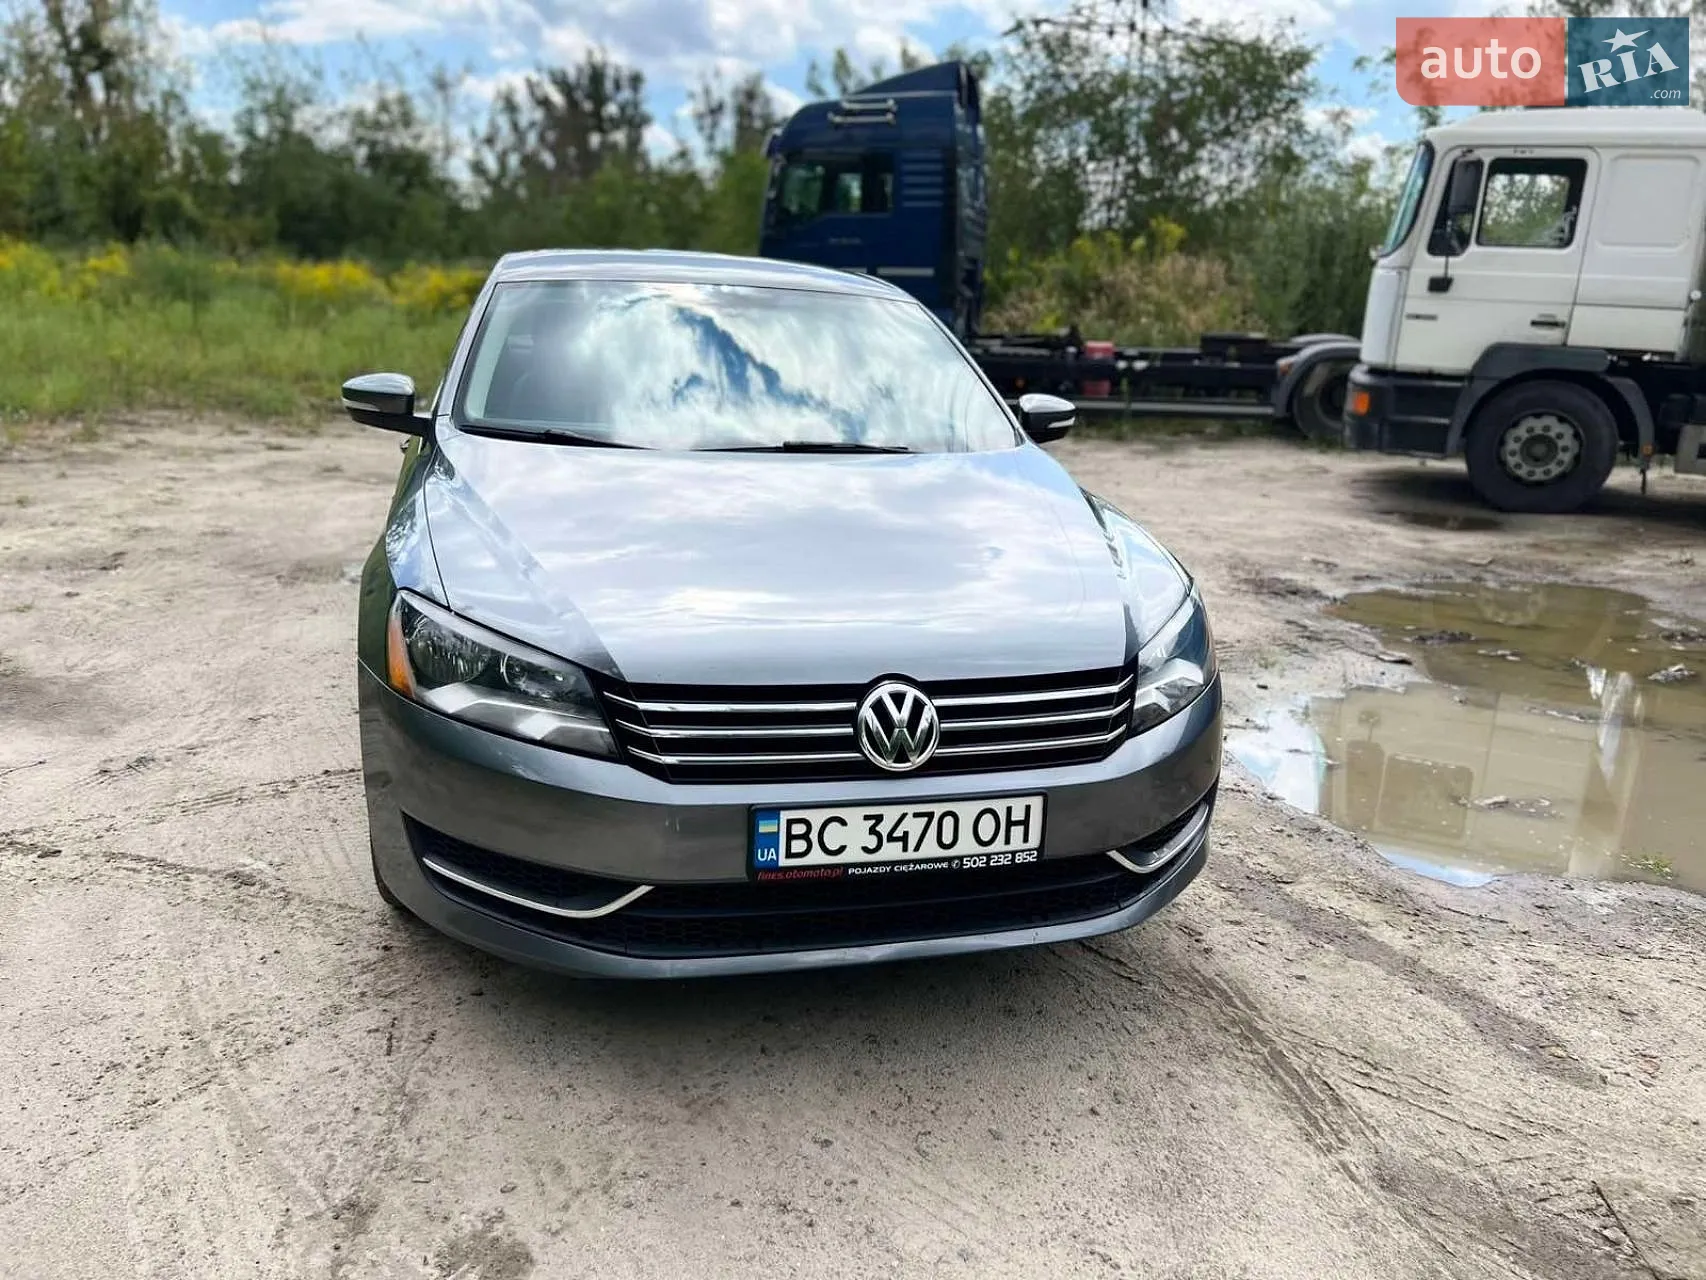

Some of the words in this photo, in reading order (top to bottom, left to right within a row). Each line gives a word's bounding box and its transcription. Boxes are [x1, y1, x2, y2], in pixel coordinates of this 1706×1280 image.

[861, 685, 936, 769] VW
[784, 815, 848, 859] BC
[861, 810, 960, 855] 3470
[972, 804, 1032, 847] OH
[757, 848, 777, 862] UA
[848, 865, 891, 875] POJAZDY
[894, 862, 948, 872] CIĘŻAROWE
[963, 856, 987, 869] 502
[990, 853, 1012, 866] 232
[1015, 850, 1037, 863] 852
